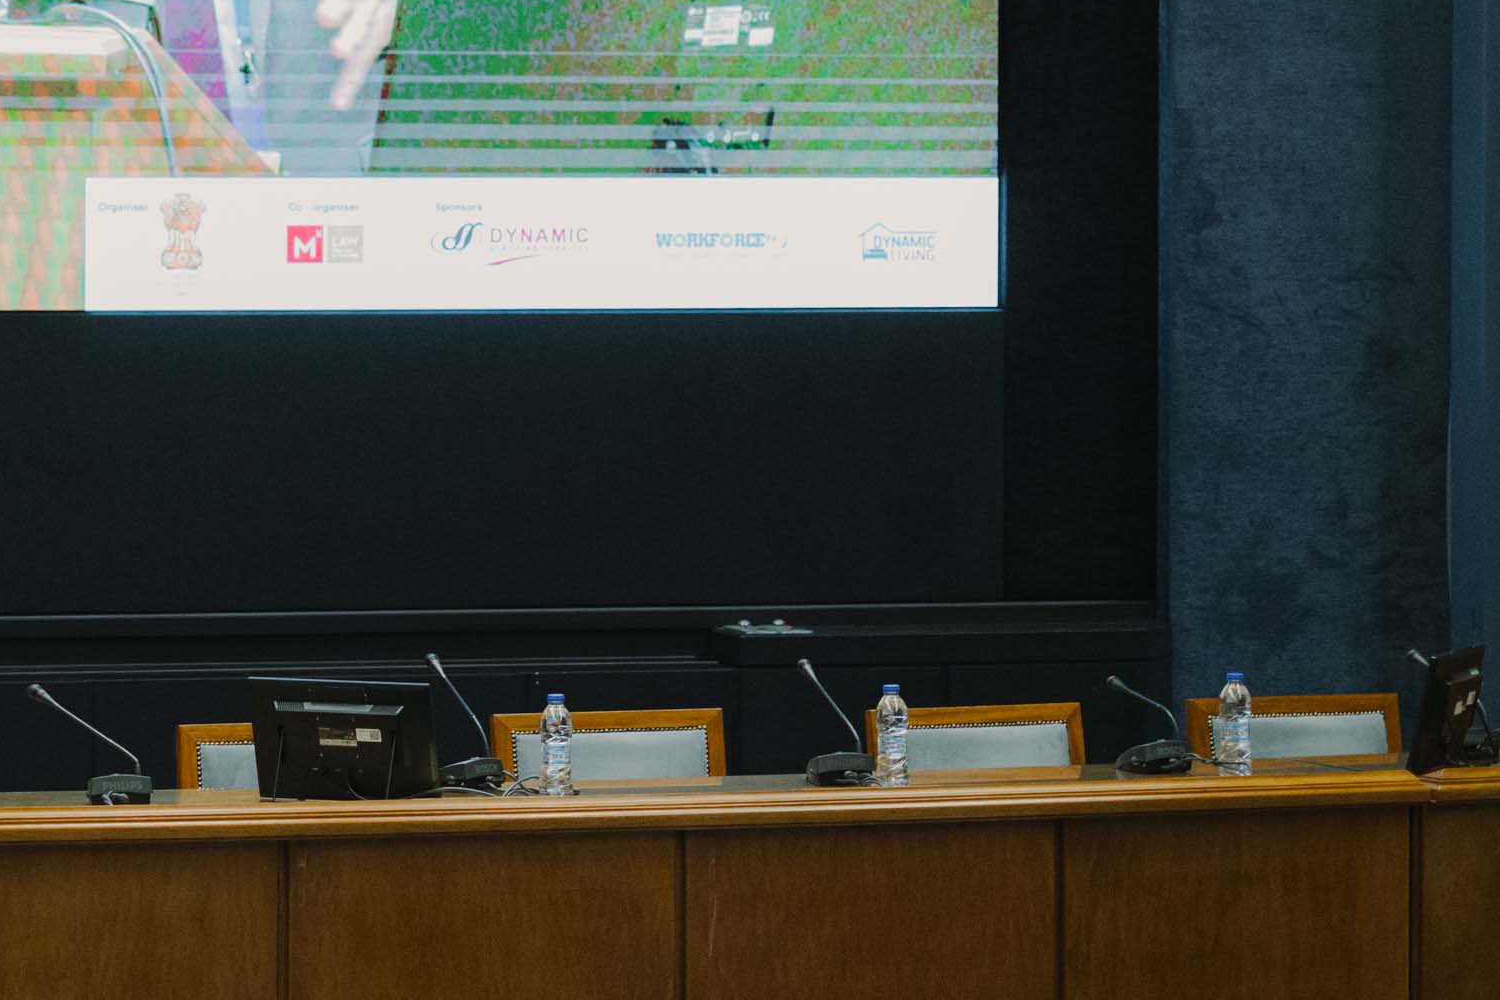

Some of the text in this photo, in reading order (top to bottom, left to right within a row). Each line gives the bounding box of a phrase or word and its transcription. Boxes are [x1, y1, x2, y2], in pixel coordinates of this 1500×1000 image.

[490, 227, 589, 243] DYNAMIC
[873, 235, 934, 249] DYNAMIC
[890, 249, 934, 261] LIVING
